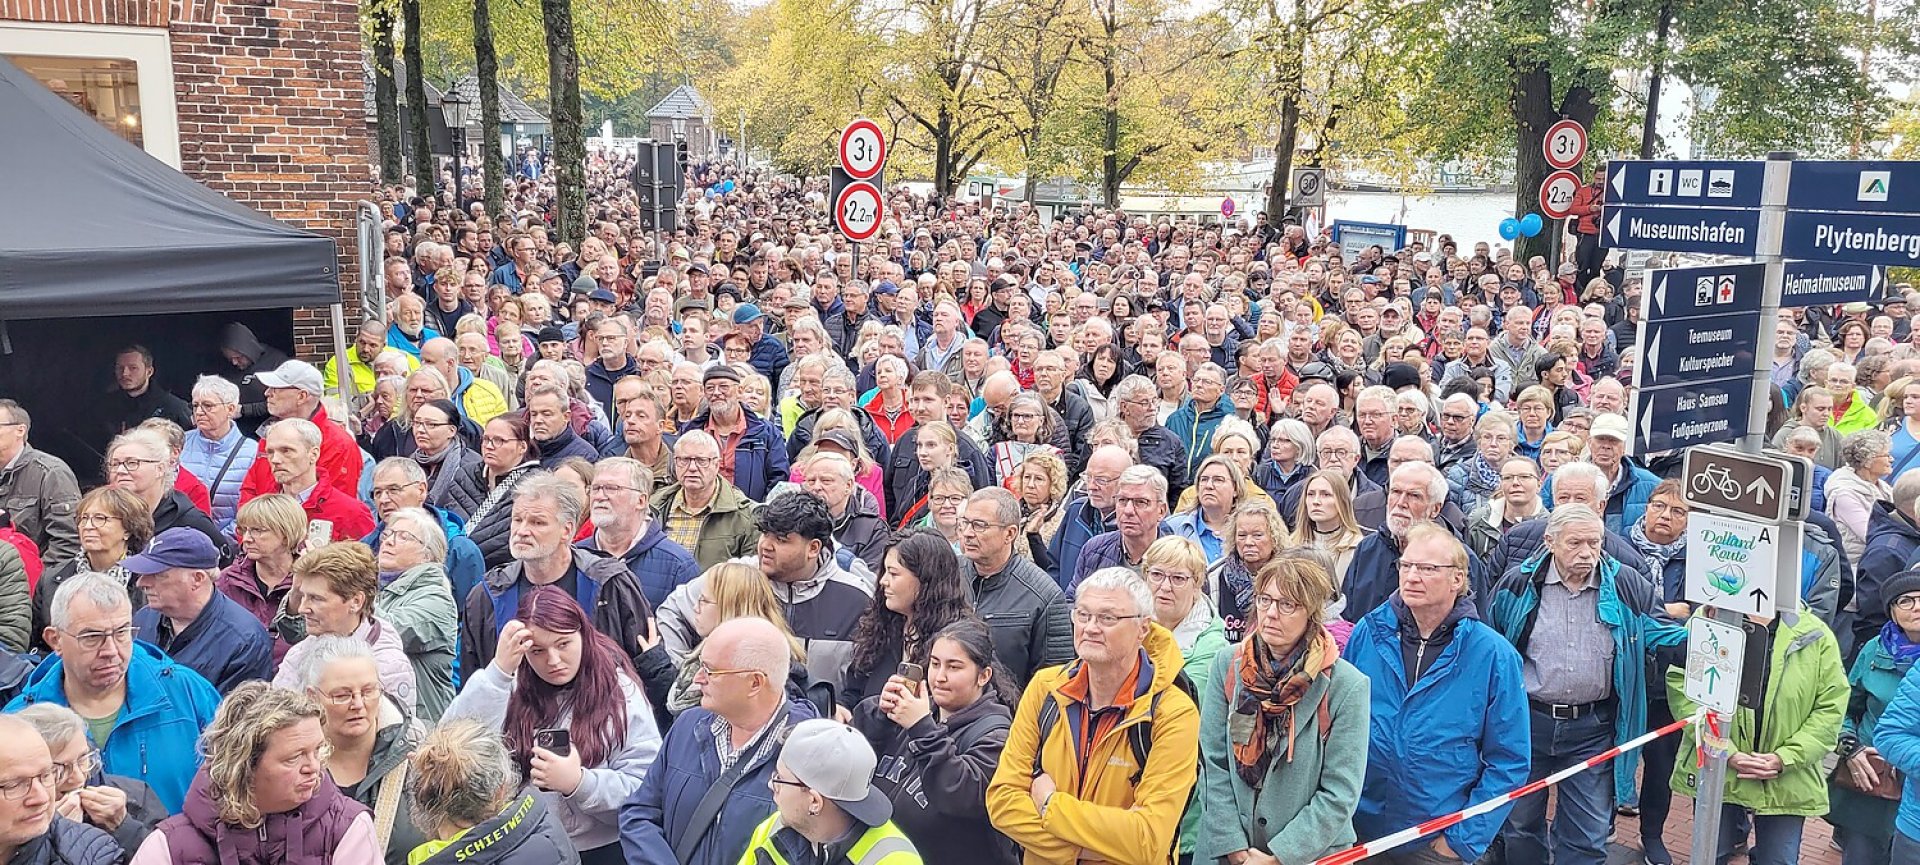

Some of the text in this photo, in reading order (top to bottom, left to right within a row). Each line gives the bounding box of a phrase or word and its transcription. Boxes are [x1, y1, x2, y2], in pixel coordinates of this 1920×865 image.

[1302, 178, 1316, 190] 30
[1681, 177, 1699, 189] WC
[1629, 217, 1745, 244] Museumshafen
[1814, 224, 1920, 259] Plytenberg
[1784, 272, 1866, 296] Heimatmuseum
[1688, 326, 1733, 345] Teemuseum
[1678, 353, 1735, 372] Kulturspeicher
[1676, 391, 1729, 412] Haus Samson
[1671, 417, 1728, 440] Fußgängerzone
[1700, 529, 1757, 551] Dollard
[1758, 527, 1771, 545] A
[1707, 543, 1749, 563] Route
